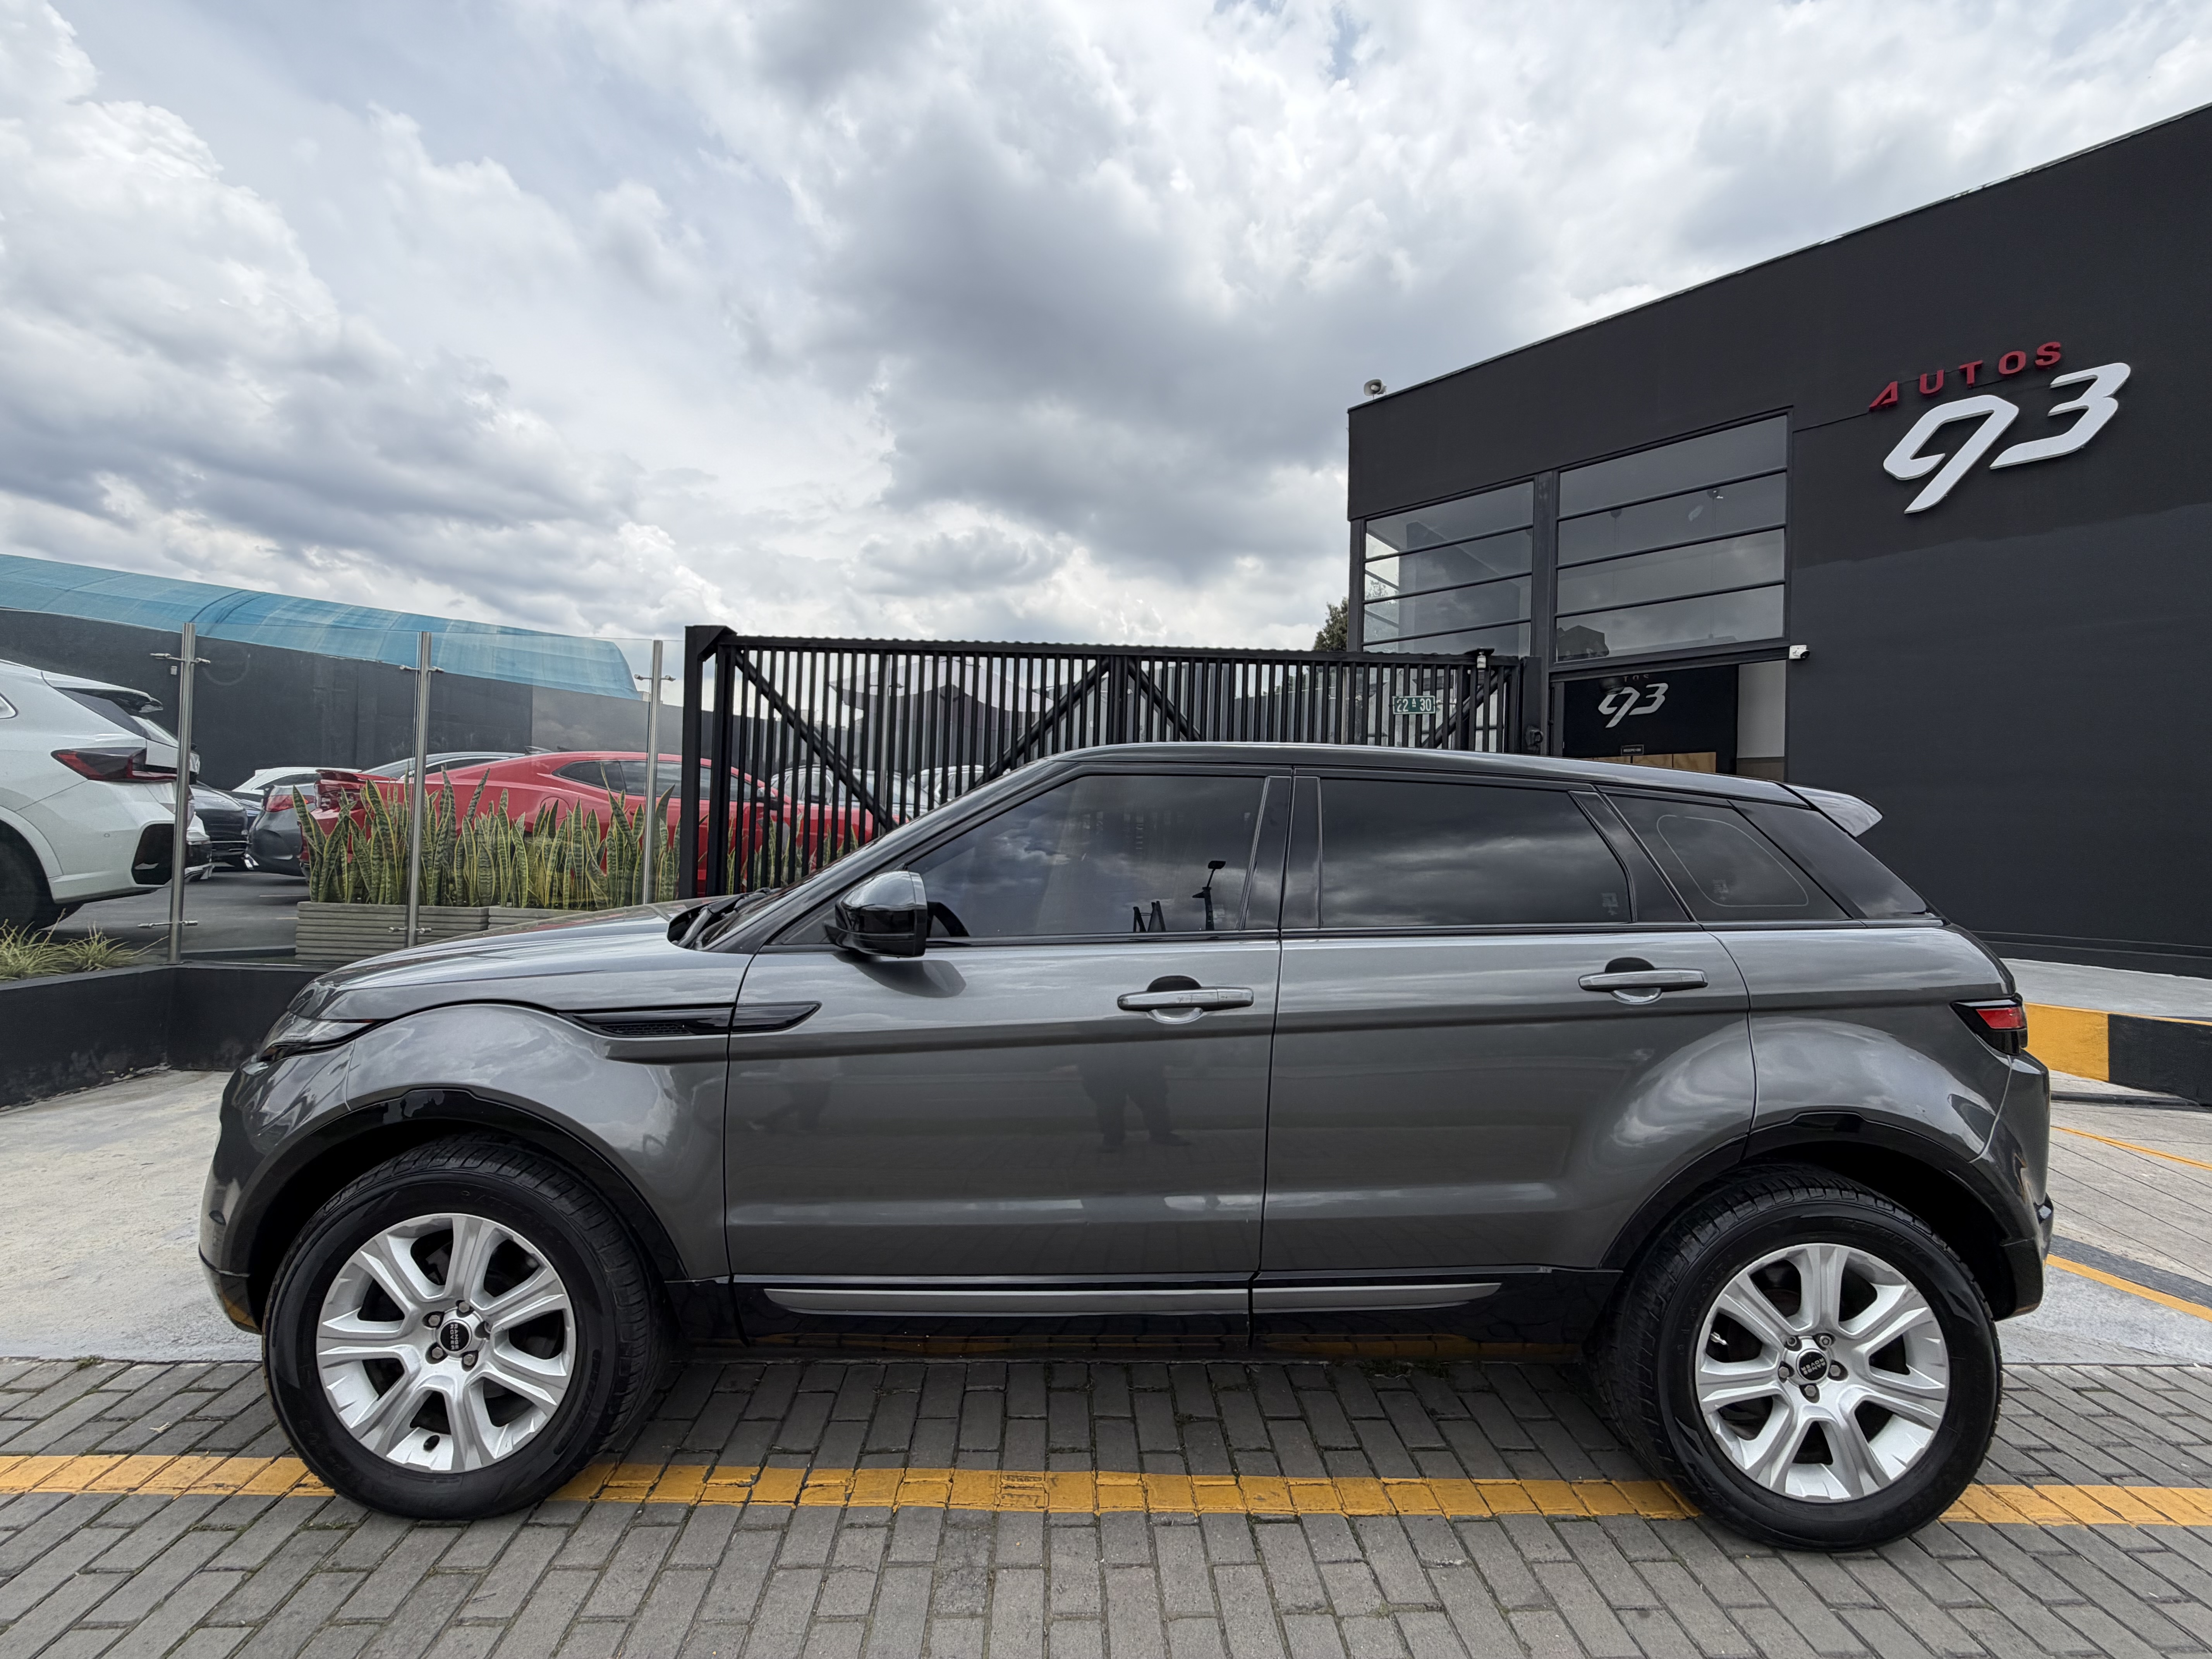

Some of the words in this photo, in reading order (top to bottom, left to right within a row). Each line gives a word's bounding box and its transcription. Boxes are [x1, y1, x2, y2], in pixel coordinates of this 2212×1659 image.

[1868, 342, 2061, 410] AUTOS
[1883, 362, 2131, 514] 93
[1396, 699, 1409, 712] 22
[1419, 698, 1432, 711] 30
[1598, 683, 1669, 728] 93
